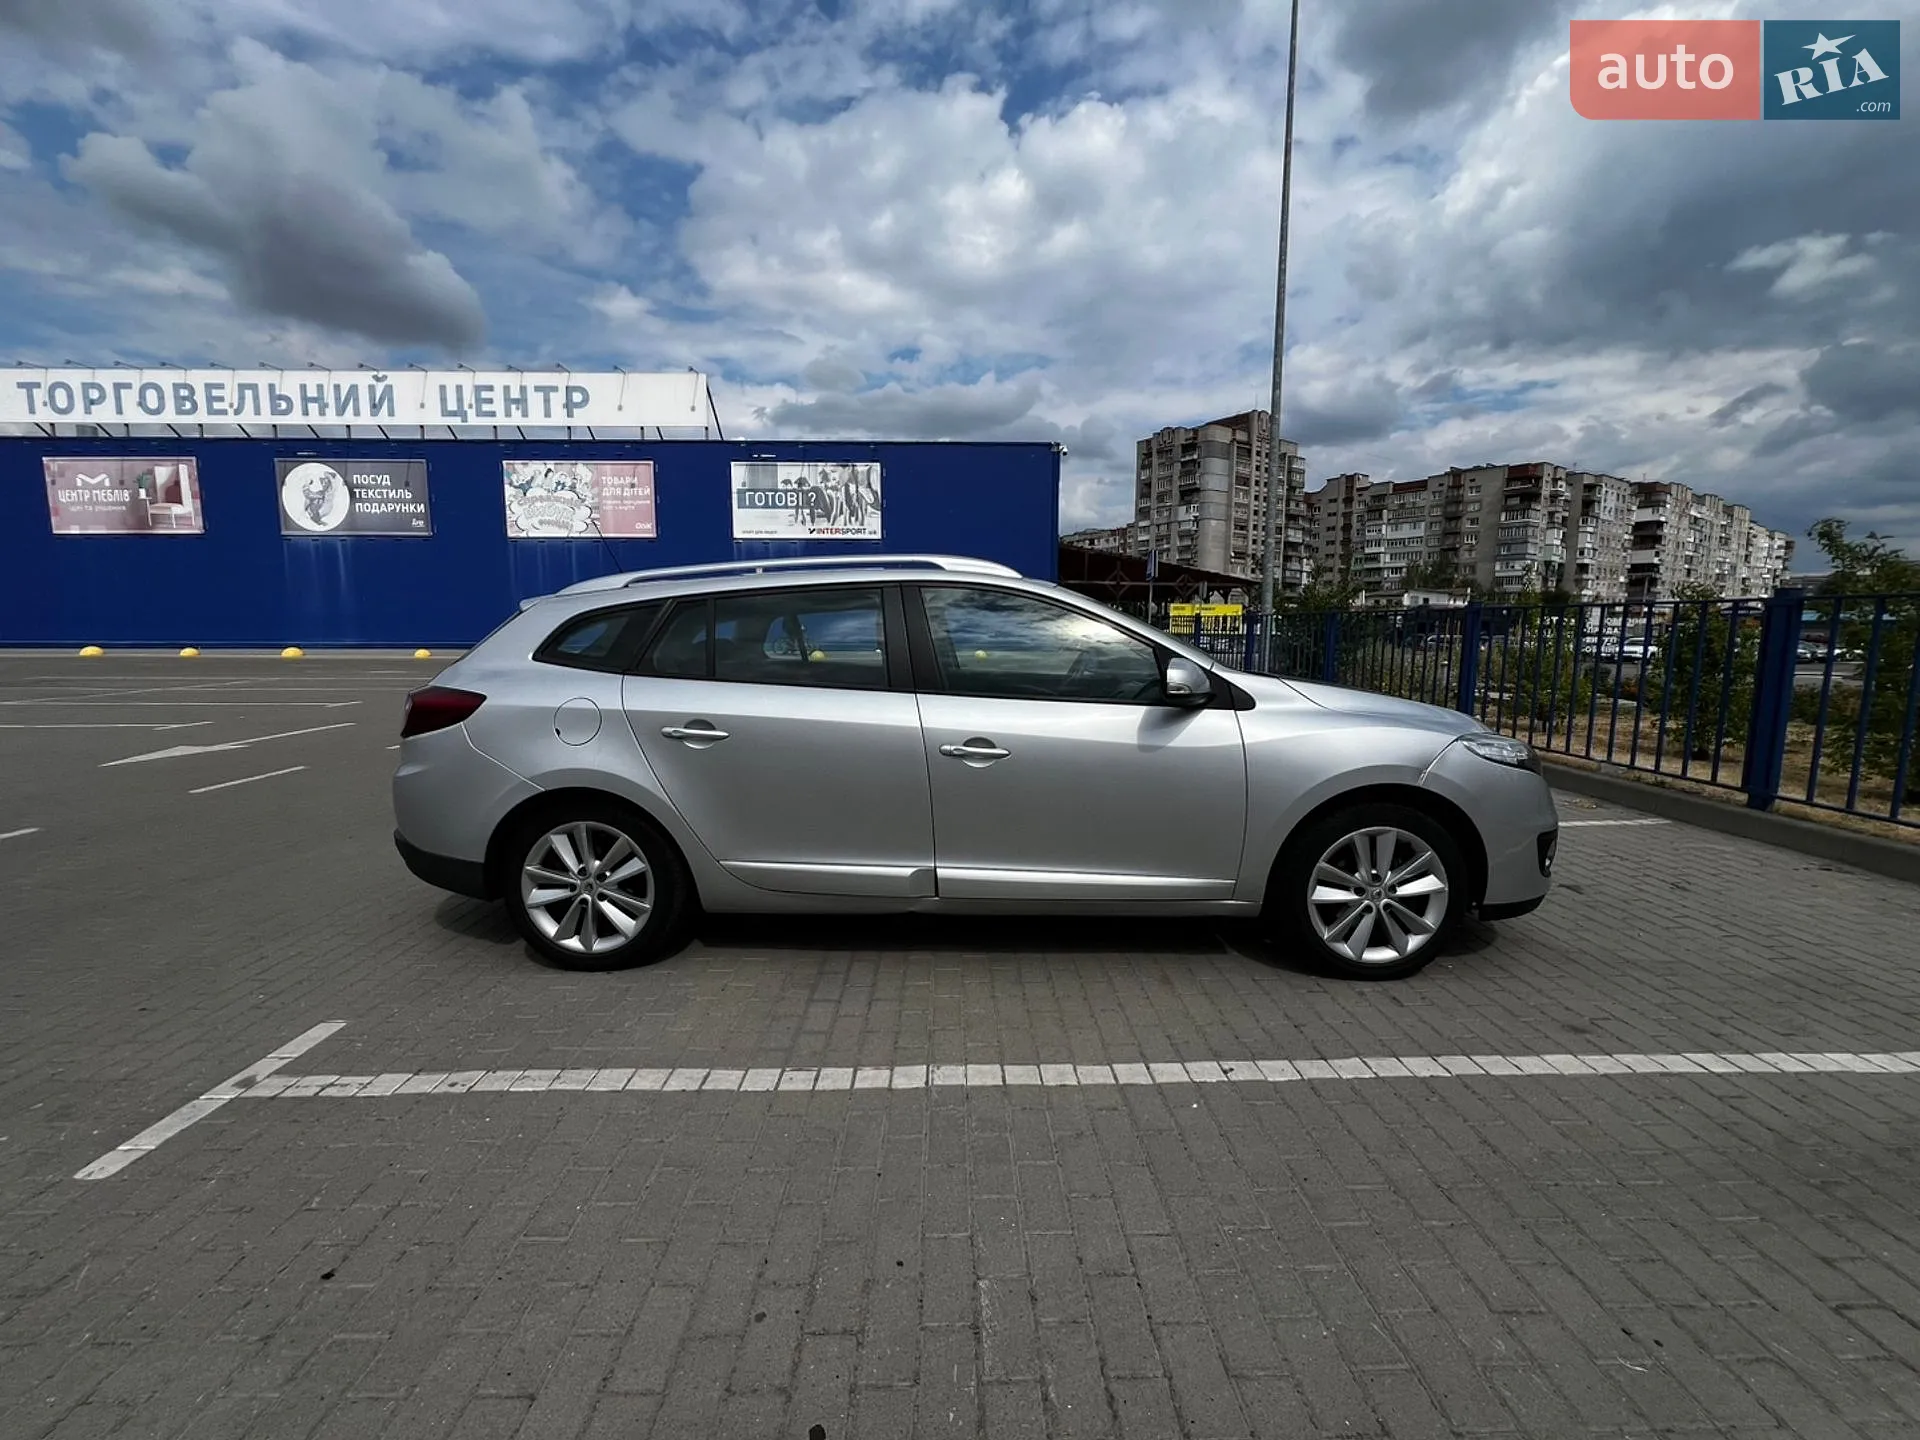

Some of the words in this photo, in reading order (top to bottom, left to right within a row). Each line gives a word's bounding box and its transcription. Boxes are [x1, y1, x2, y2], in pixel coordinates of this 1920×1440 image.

[16, 374, 396, 417] ТОРГОВЕЛЬНИЙ
[438, 385, 590, 423] ЦЕНТР
[353, 474, 391, 486] ПОСУД
[58, 489, 90, 504] ЦЕНТР
[353, 489, 412, 499] ТЕКСТИЛЬ
[355, 503, 425, 514] ПОДАРУНКИ
